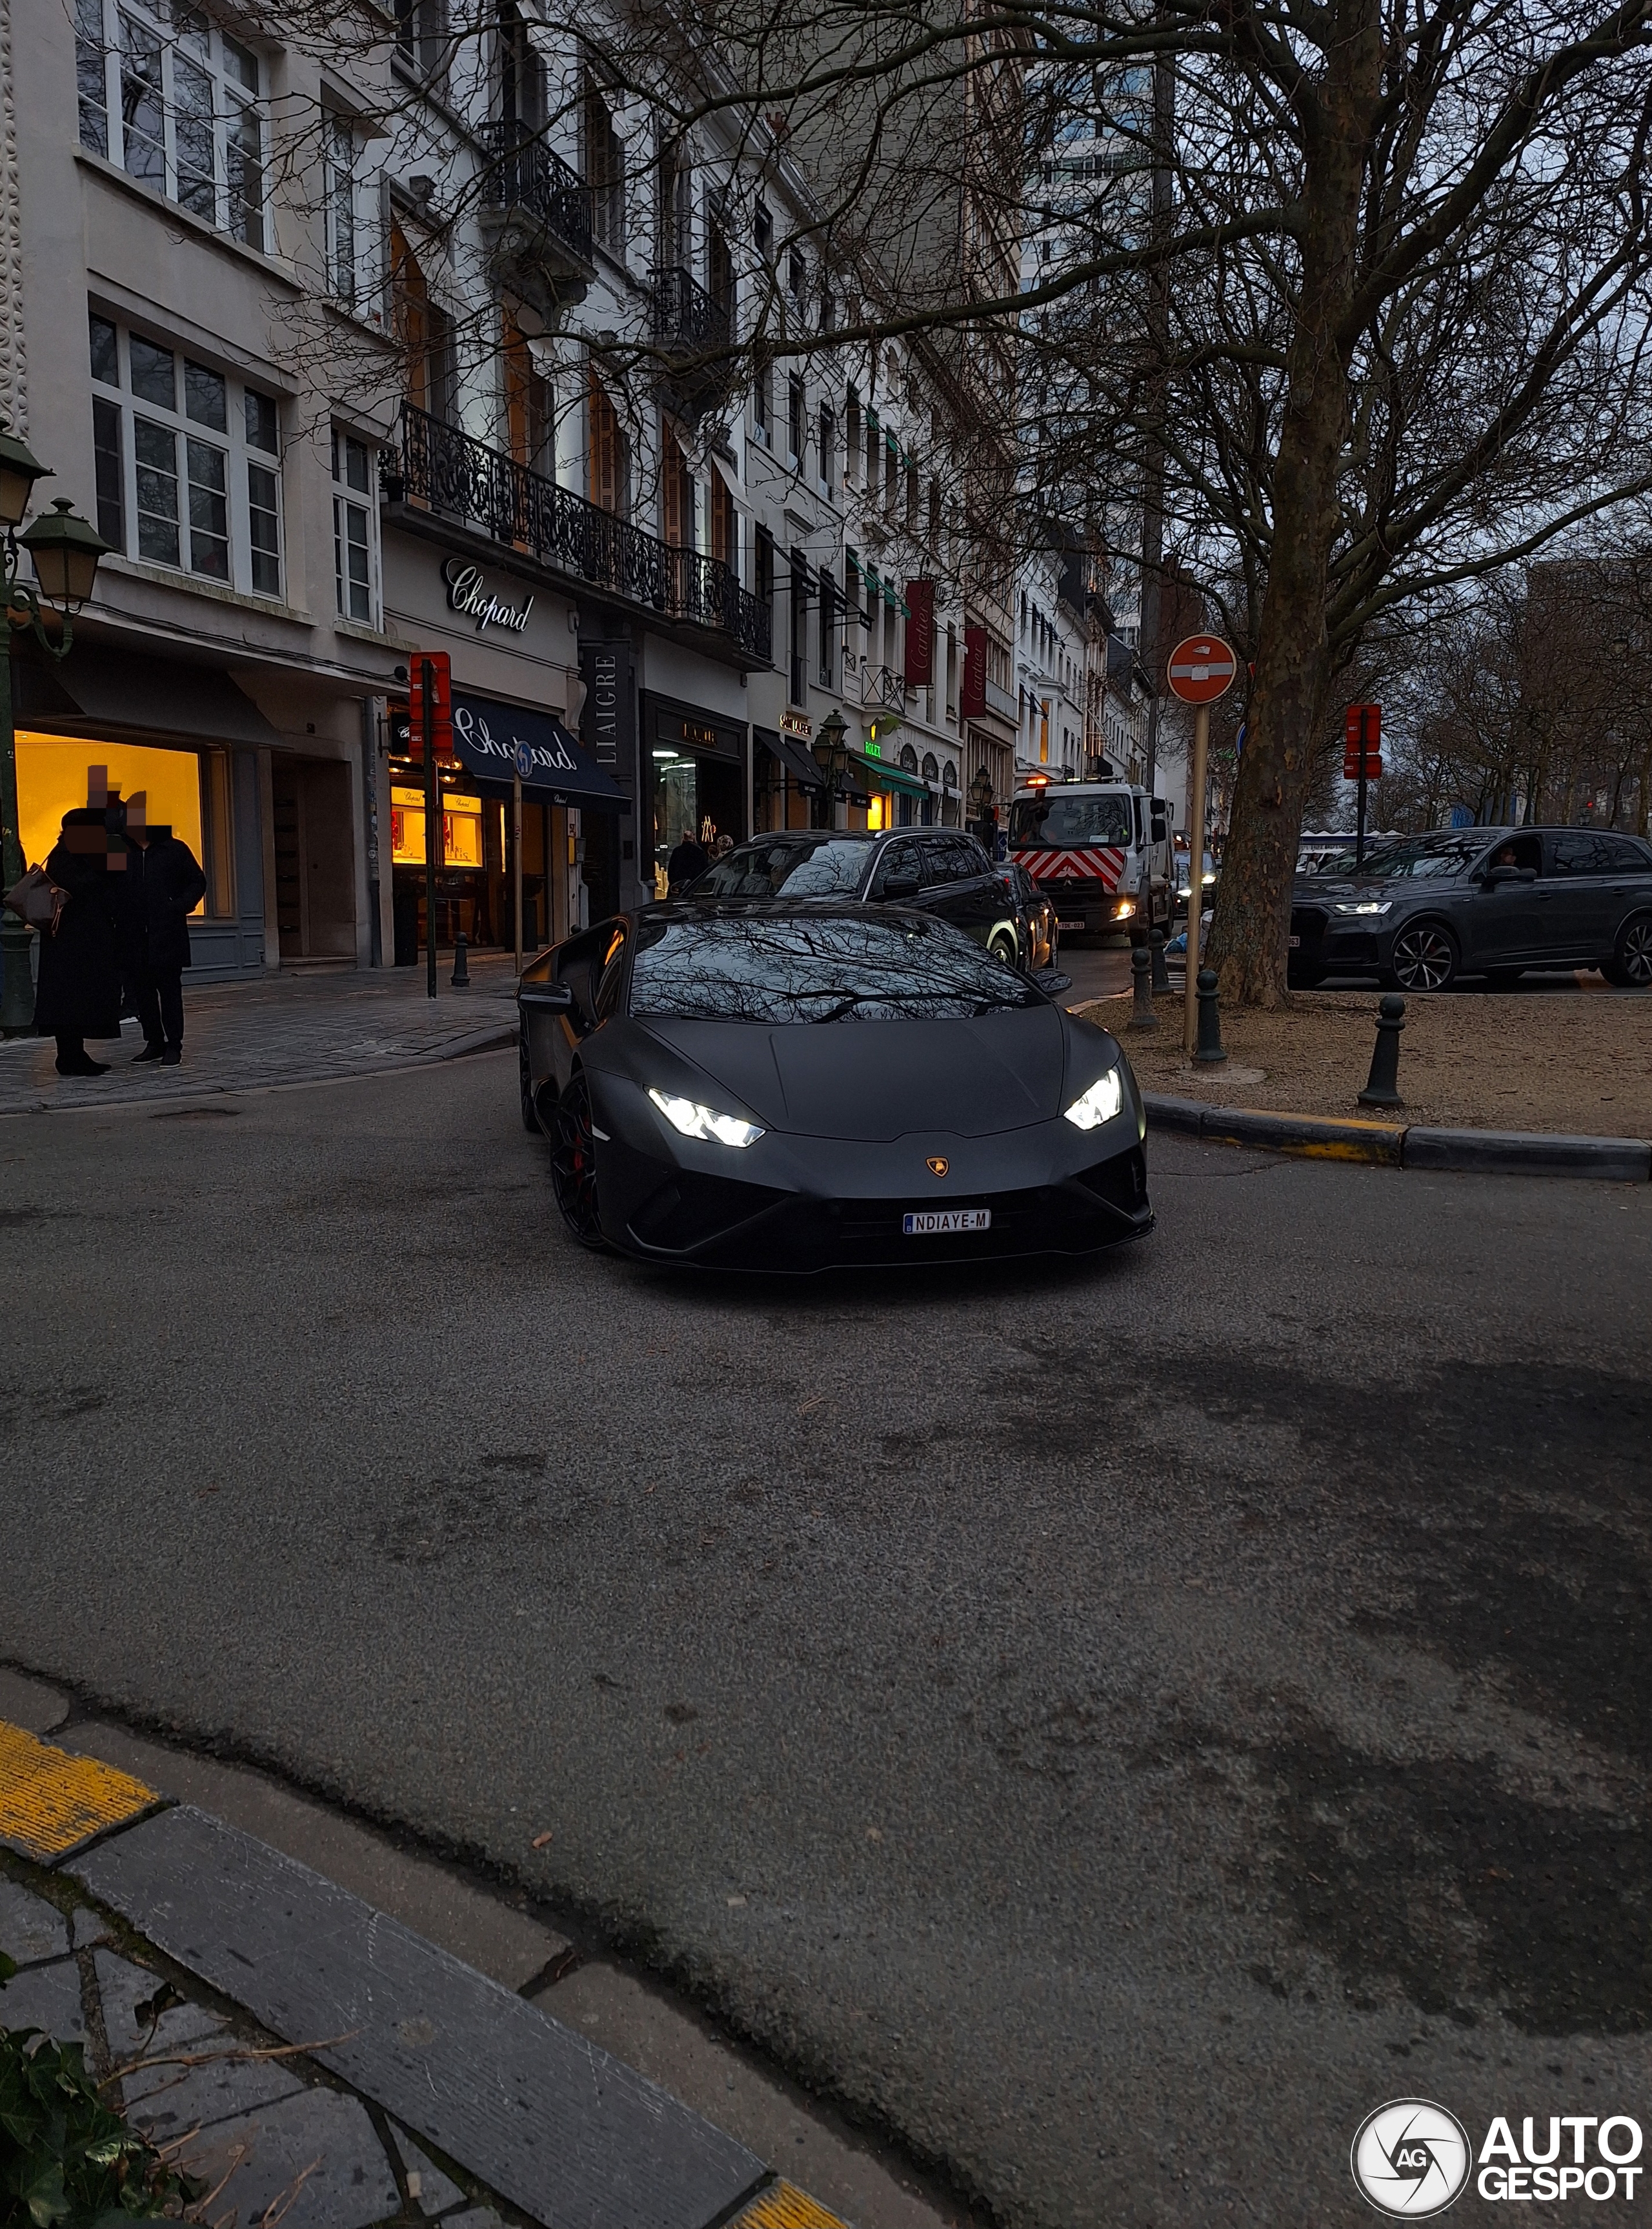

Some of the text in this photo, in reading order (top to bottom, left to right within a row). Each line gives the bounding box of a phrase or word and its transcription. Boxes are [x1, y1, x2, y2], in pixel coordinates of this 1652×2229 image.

[446, 558, 535, 632] Chopard
[911, 606, 929, 669] Cartier
[968, 644, 984, 701] Cartier
[452, 707, 577, 771] Choard
[596, 656, 617, 765] LIAIGRE
[865, 741, 881, 758] ROLEX
[903, 754, 914, 770] Cartier
[916, 1213, 986, 1231] NDIAYE-M
